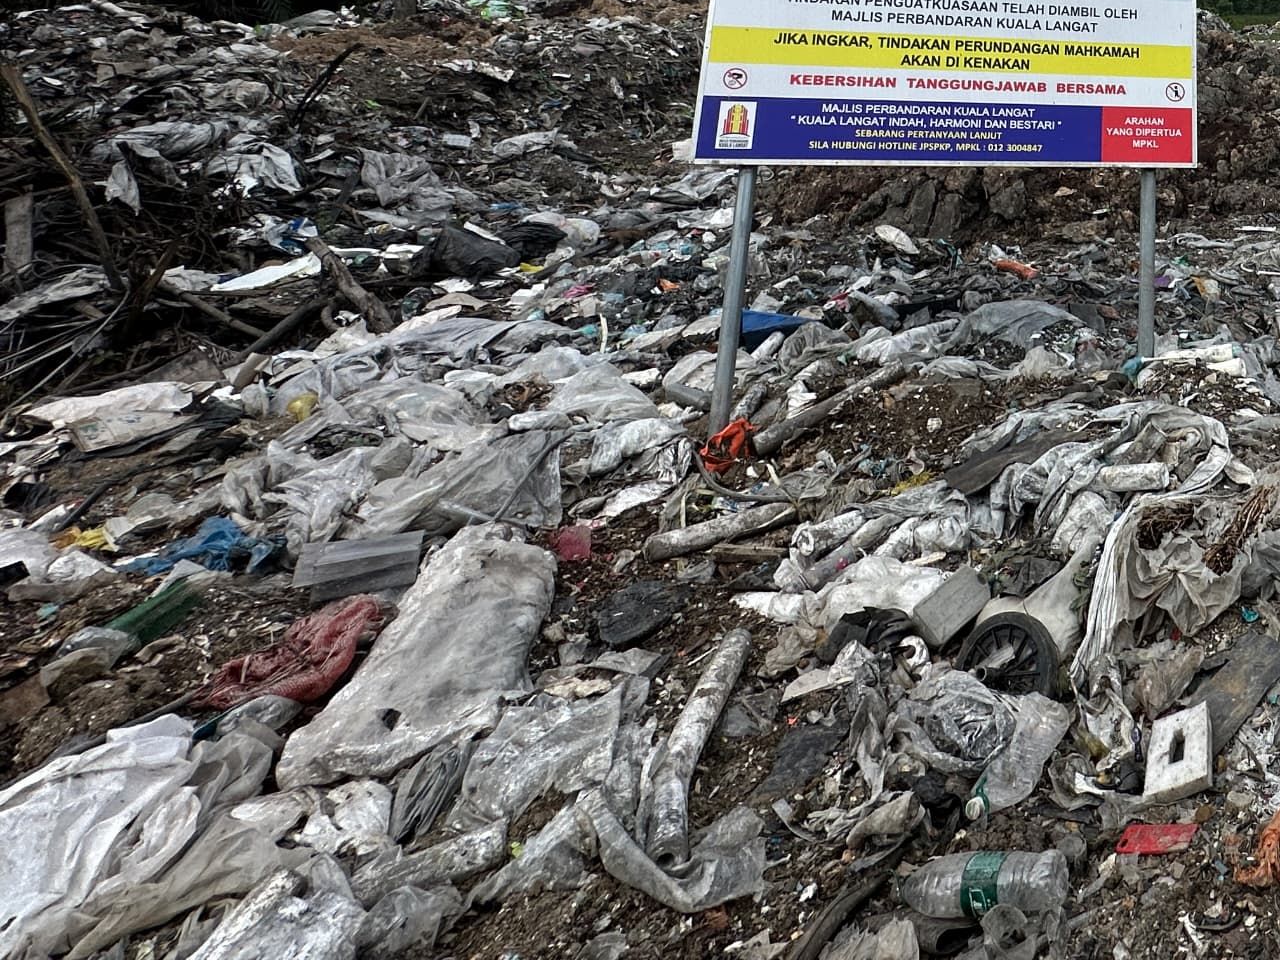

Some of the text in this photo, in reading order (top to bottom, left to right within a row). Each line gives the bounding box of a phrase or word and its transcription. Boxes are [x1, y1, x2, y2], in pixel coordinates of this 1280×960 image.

[1002, 2, 1045, 15] TELAH
[1048, 5, 1100, 18] DIAMBIL
[1104, 8, 1138, 20] OLEH
[831, 10, 1098, 33] MAJLIS PERBANDARAN KUALA LANGAT
[774, 32, 1140, 59] JIKA INGKAR, TINDAKAN PERUNDANGAN MAHKAMAH
[900, 54, 1030, 70] AKAN DI KENAKAN
[790, 74, 1127, 95] KEBERSIHAN TANGGUNGJAWAB BERSAMA
[822, 103, 1035, 118] MAJLIS PERBANDARAN KUALA LANGAT
[798, 115, 837, 125] KUALA
[839, 116, 886, 126] LANGAT
[888, 117, 927, 128] INDAH,
[929, 118, 981, 129] HARMONI
[984, 119, 1007, 129] DAN
[1009, 120, 1055, 130] BESTARI
[1124, 117, 1164, 126] ARAHAN
[855, 129, 1003, 140] SEBARANG PERTANYAAN LANJUT
[1106, 128, 1182, 137] YANG DIPERTUA
[808, 140, 829, 149] SILA
[831, 141, 876, 150] HUBUNGI
[878, 142, 917, 150] HOTLINE
[956, 143, 981, 151] MPKL
[987, 143, 1004, 152] 012
[1132, 139, 1159, 148] MPKL
